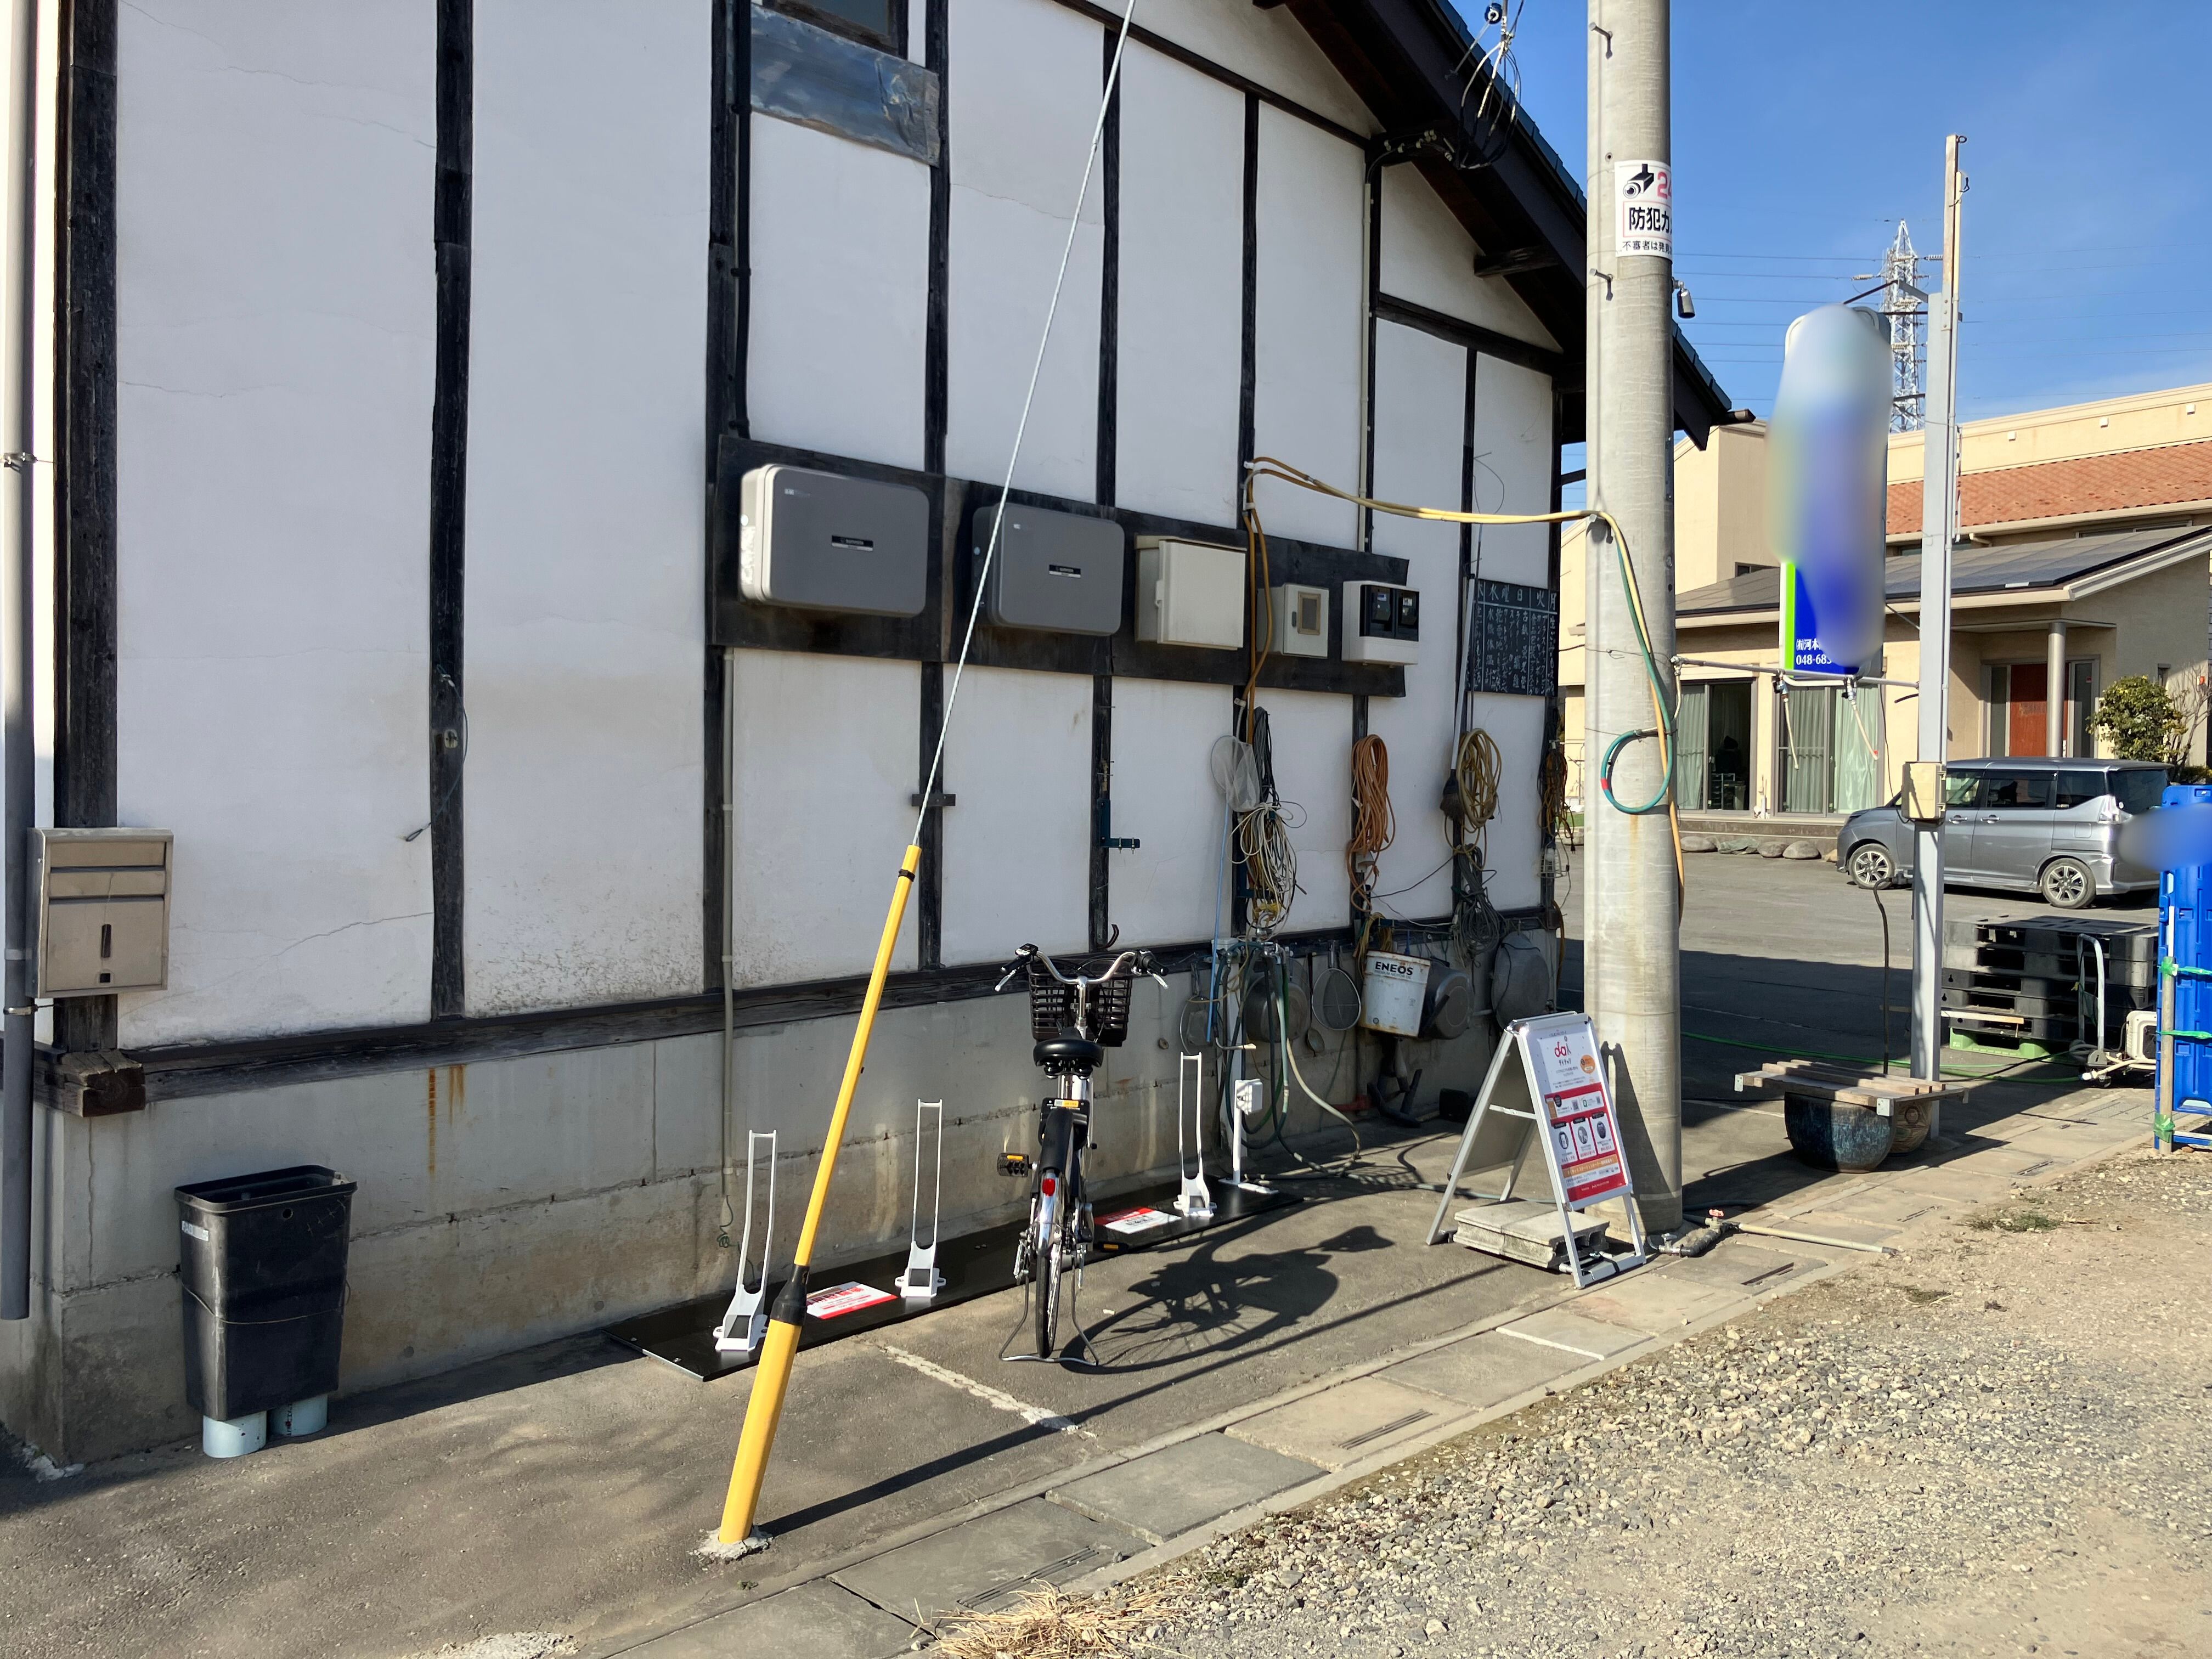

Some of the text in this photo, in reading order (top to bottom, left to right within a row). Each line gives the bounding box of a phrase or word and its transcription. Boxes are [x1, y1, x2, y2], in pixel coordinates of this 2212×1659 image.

[1629, 207, 1672, 234] 防犯カ
[1488, 583, 1523, 602] 水曜日
[1536, 590, 1545, 608] 火
[1549, 592, 1557, 611] 月
[1796, 638, 1821, 651] (有)河本
[1375, 961, 1413, 975] ENEOS
